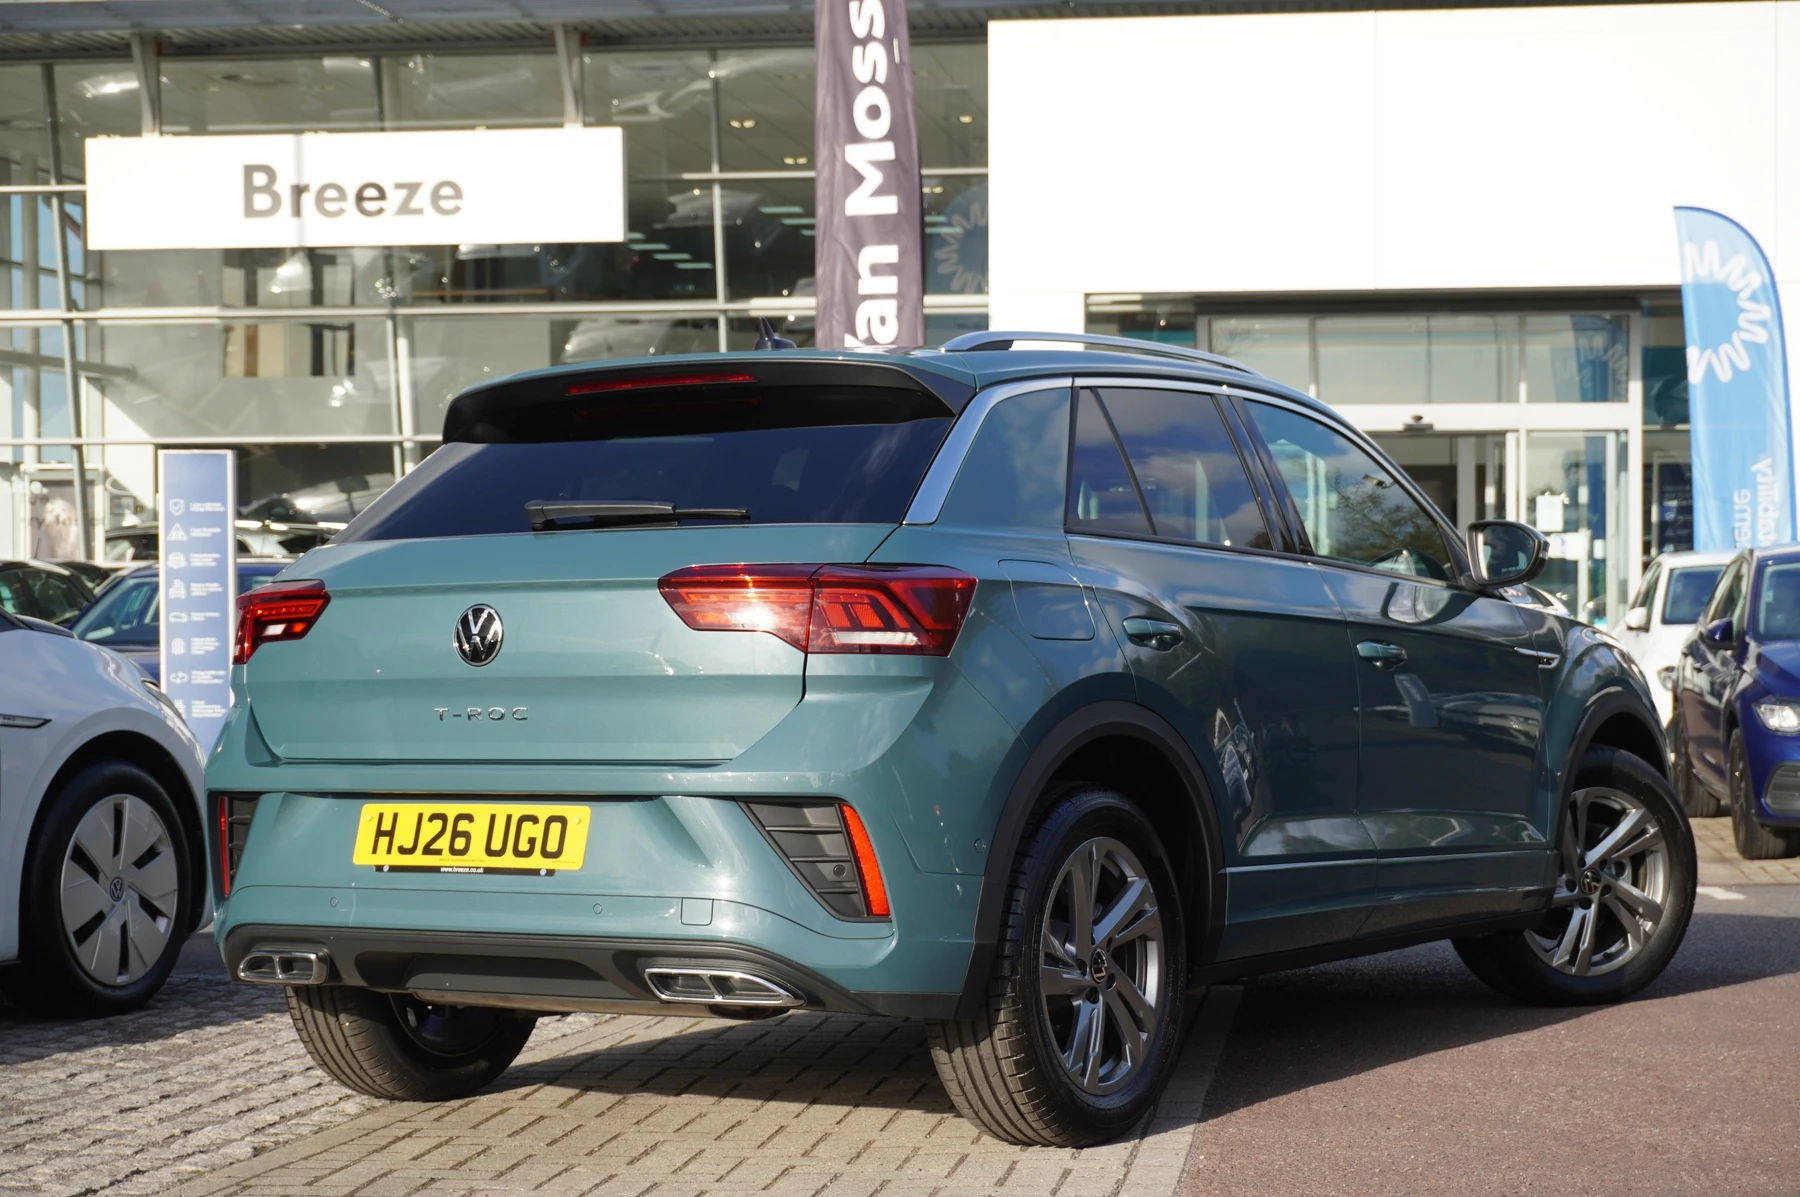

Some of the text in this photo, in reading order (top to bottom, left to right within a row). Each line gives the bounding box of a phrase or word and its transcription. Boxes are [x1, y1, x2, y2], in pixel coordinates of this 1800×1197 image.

[242, 163, 464, 219] Breeze
[433, 706, 529, 721] T-ROC
[371, 811, 569, 860] HJ26 UGO
[440, 866, 485, 874] www.breeze.co.uk
